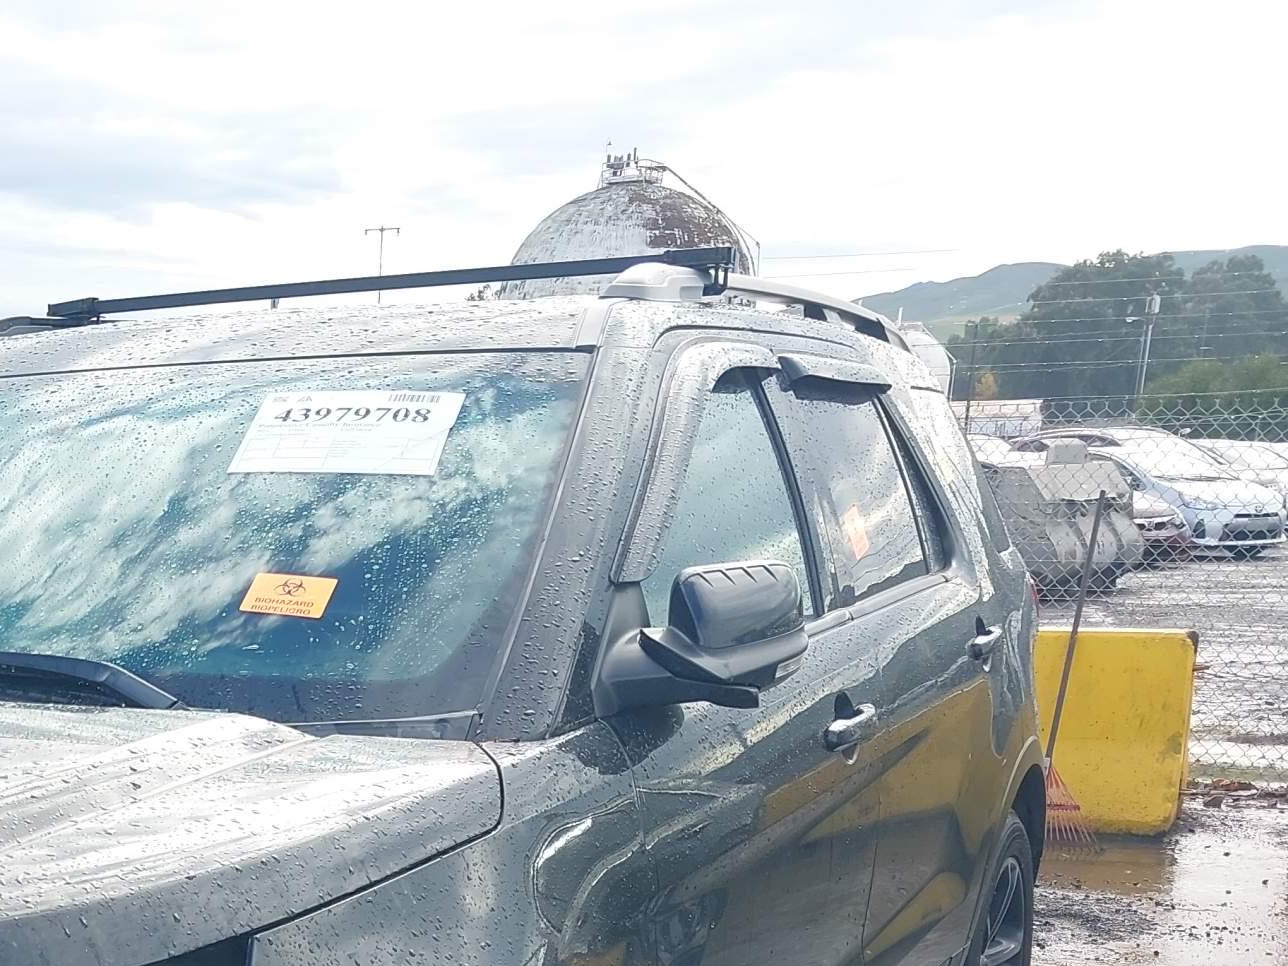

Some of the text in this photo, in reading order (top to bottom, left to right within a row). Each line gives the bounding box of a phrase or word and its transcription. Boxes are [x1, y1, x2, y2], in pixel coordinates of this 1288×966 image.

[274, 407, 431, 423] 43979708
[254, 597, 314, 608] BIOHAZARD
[251, 604, 311, 615] BIOPELIGRO
